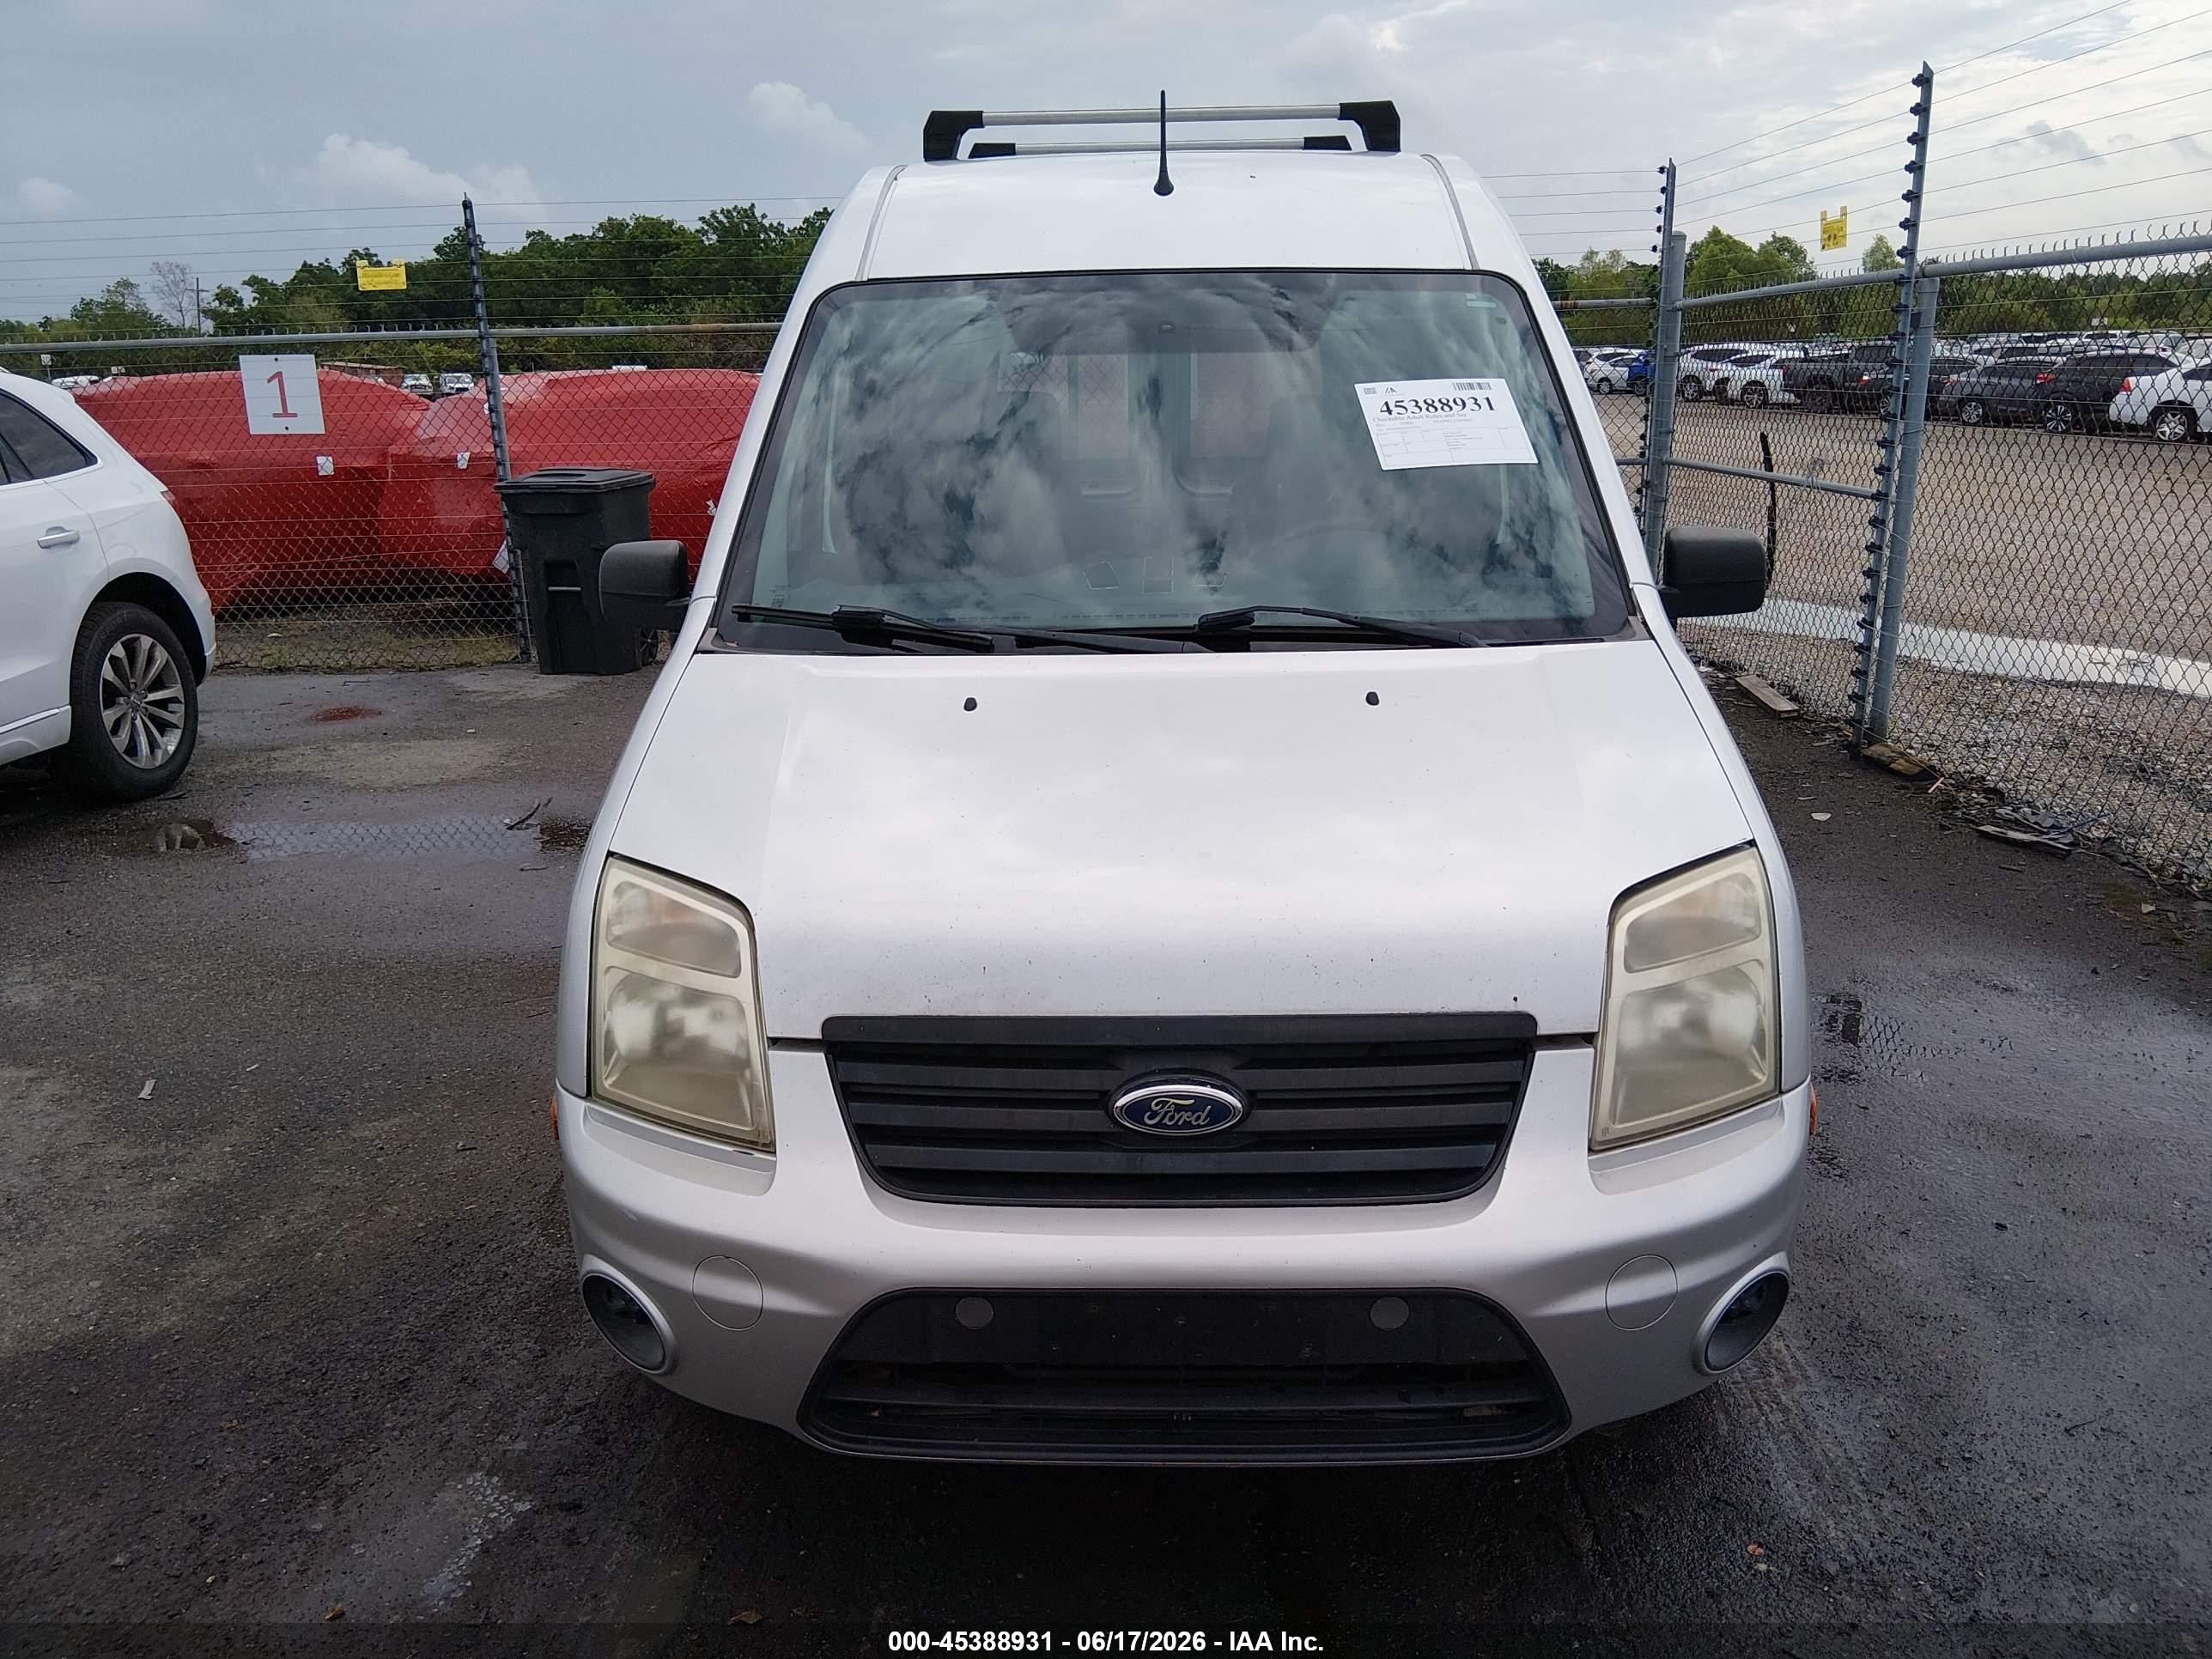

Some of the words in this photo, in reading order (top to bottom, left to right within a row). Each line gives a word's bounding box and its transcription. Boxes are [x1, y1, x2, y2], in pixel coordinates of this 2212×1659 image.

[266, 370, 298, 418] 1
[1379, 396, 1497, 416] 45388931
[1143, 1097, 1212, 1126] Ford
